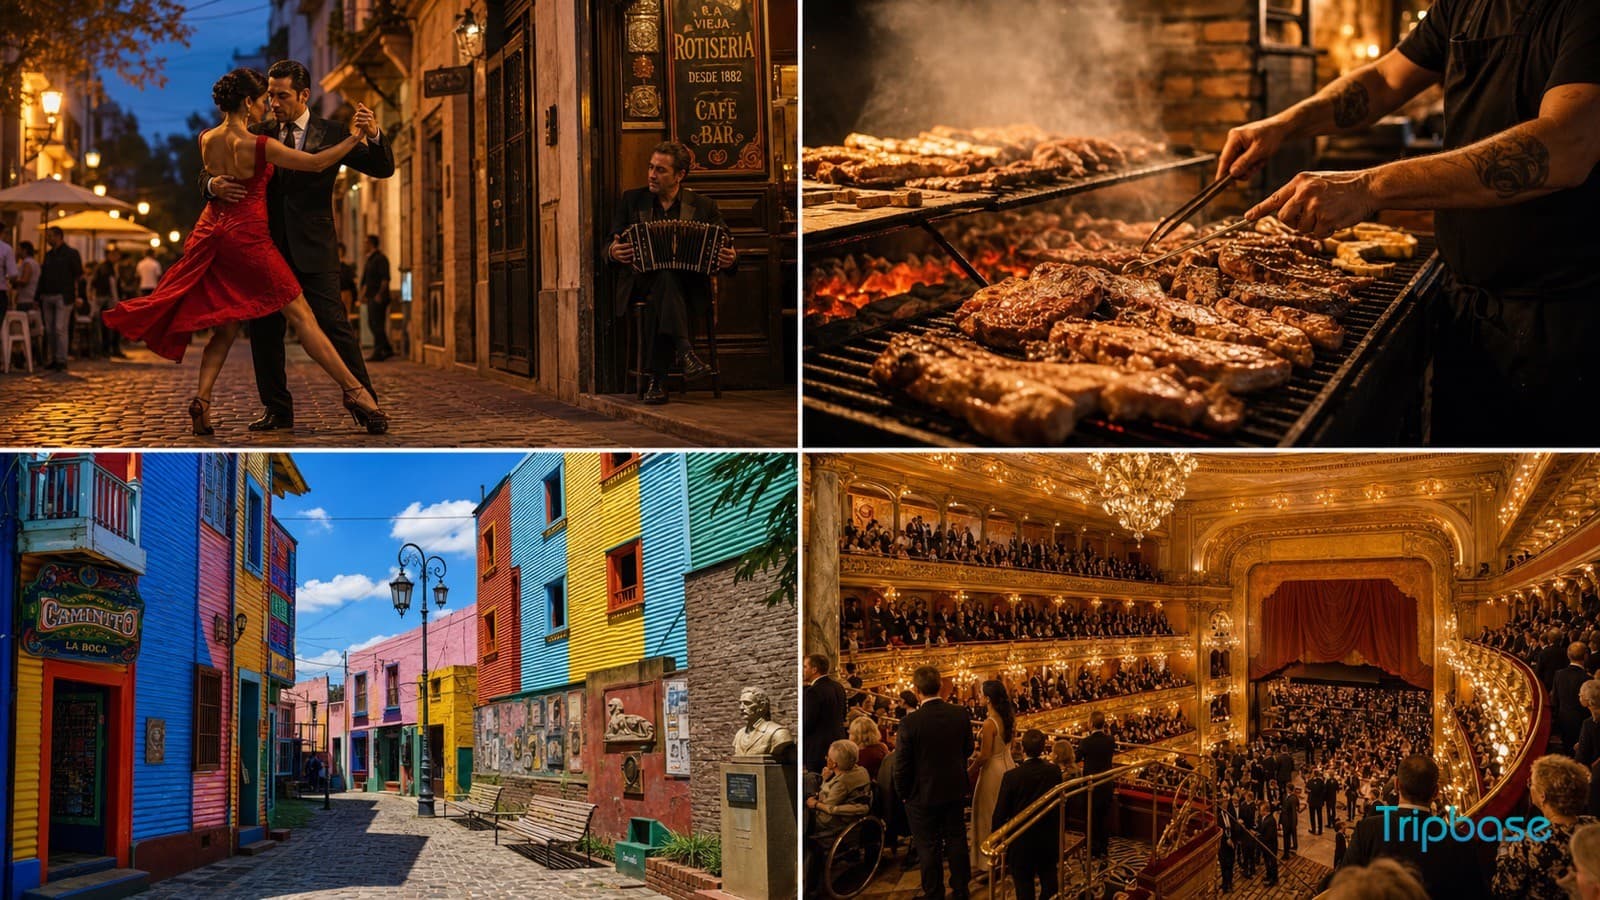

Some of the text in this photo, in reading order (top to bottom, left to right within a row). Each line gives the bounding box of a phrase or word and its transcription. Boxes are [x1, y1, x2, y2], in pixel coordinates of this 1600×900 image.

[688, 70, 742, 83] DESDE 1882
[701, 125, 734, 144] BAR
[42, 600, 135, 636] CAMINITO
[65, 640, 108, 654] LA BOCA
